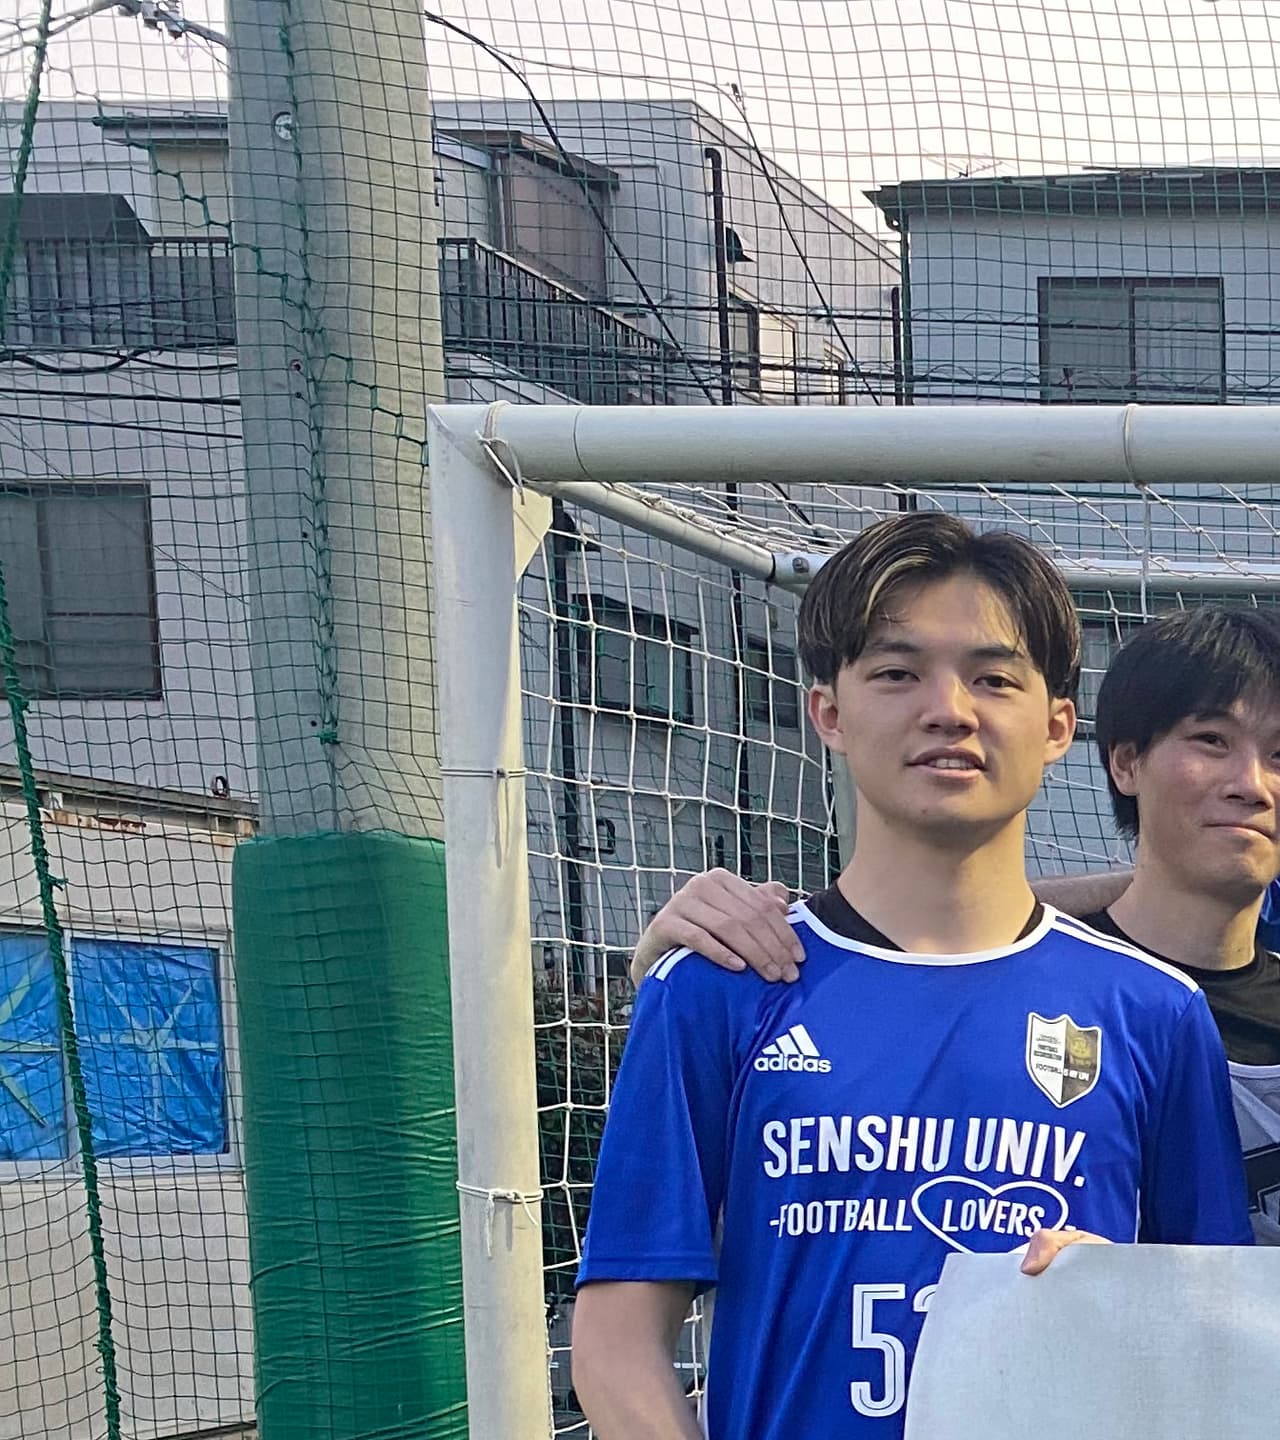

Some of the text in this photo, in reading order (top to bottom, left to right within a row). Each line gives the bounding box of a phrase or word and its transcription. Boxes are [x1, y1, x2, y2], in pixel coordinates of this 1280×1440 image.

[753, 1052, 832, 1073] adidas
[763, 1115, 1086, 1187] SENSHU UNIV.
[851, 1283, 940, 1418] 5
